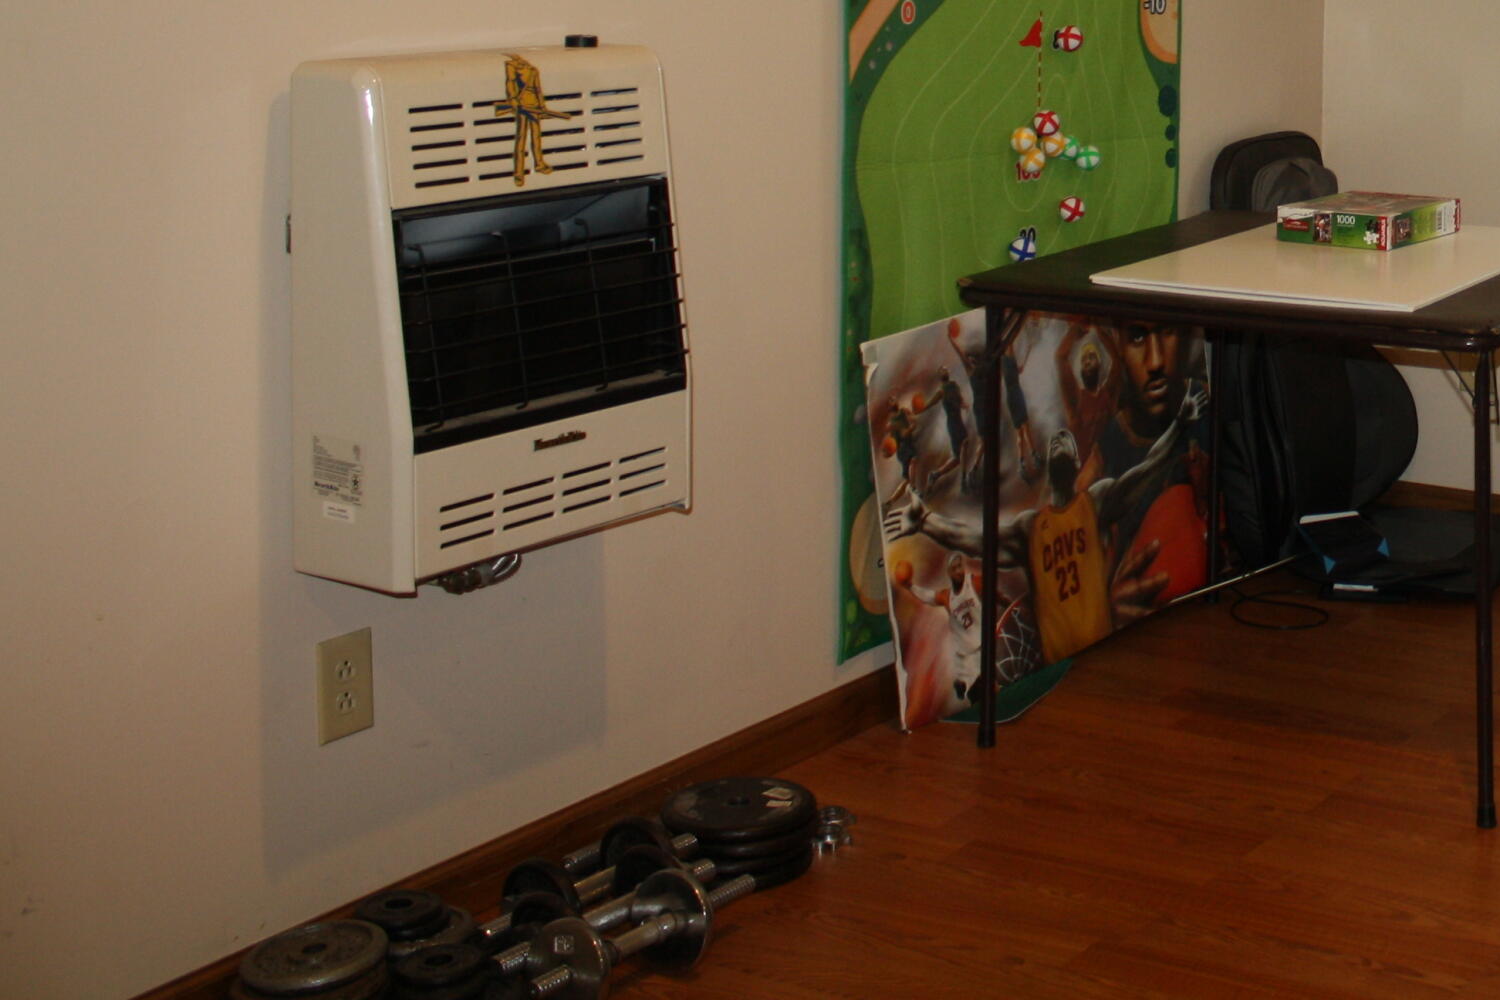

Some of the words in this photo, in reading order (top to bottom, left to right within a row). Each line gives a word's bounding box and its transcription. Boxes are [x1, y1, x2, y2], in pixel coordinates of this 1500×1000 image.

[1336, 214, 1356, 225] 1000
[1042, 527, 1086, 572] CAVS
[1056, 561, 1080, 602] 23
